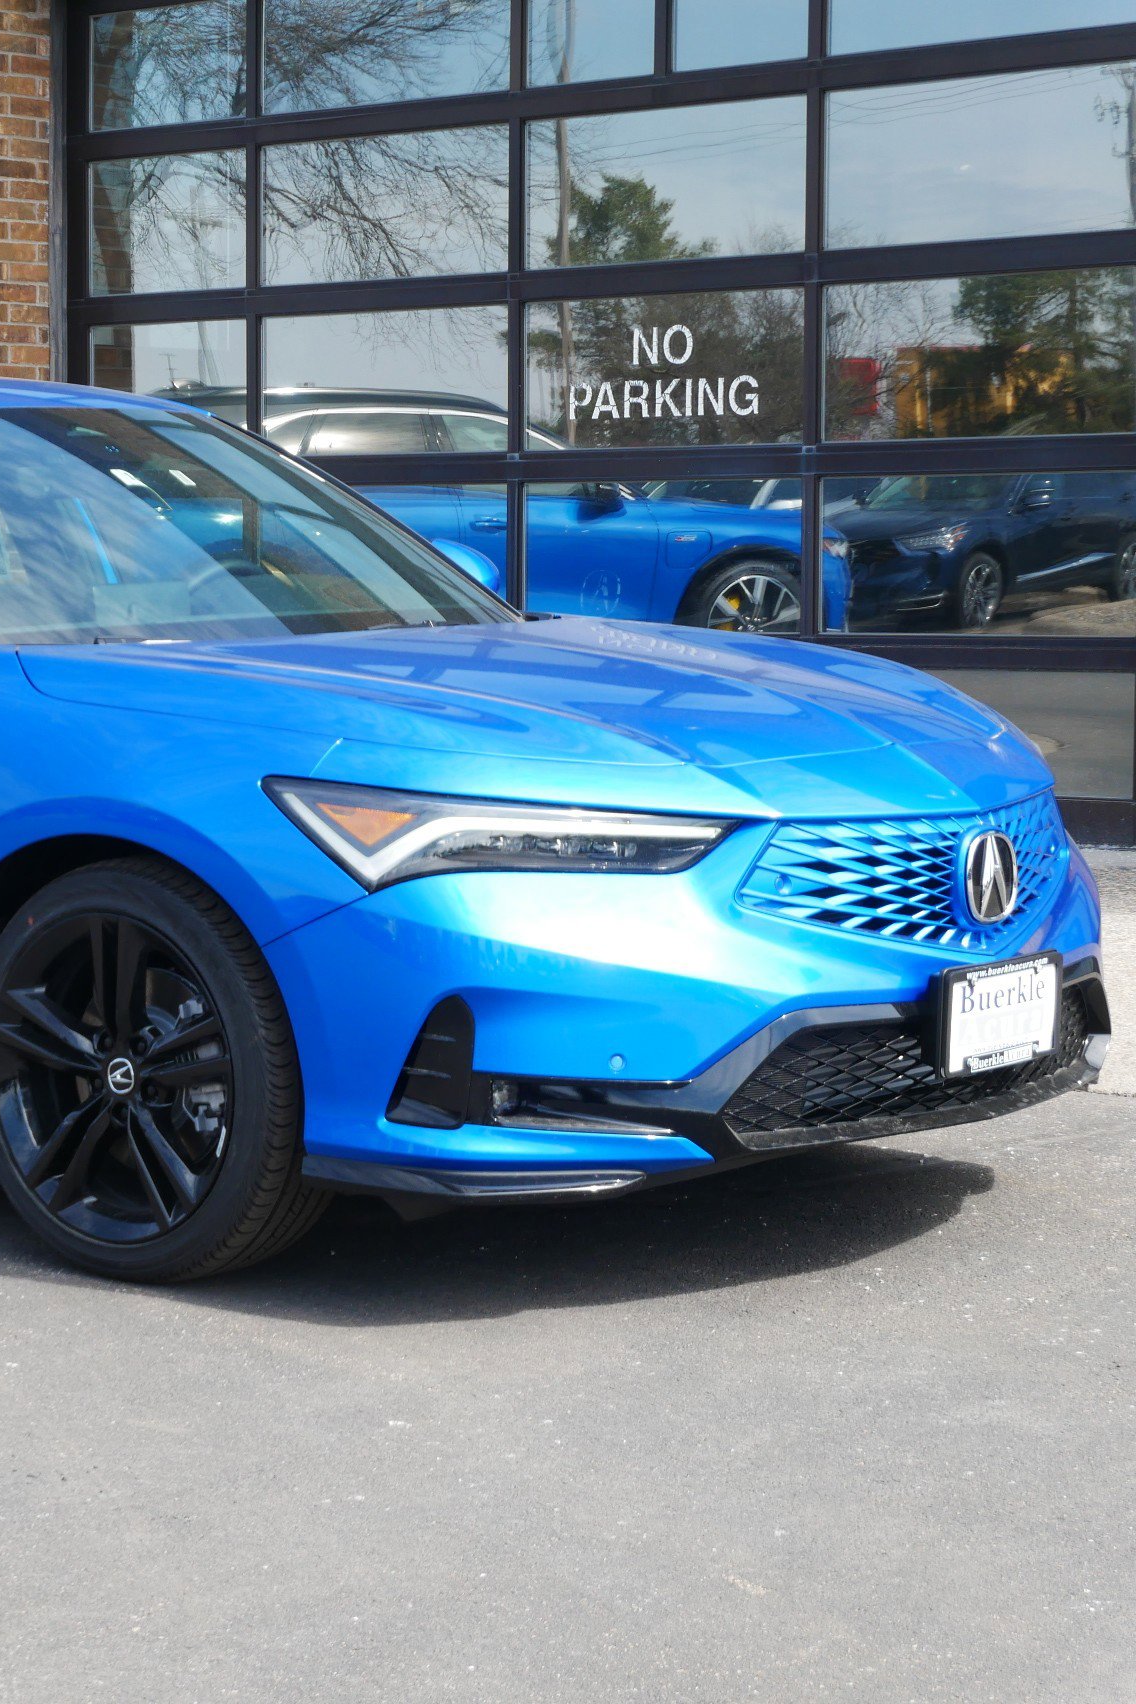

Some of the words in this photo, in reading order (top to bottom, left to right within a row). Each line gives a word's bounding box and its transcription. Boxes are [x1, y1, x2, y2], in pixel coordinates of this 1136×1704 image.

[632, 324, 694, 365] NO
[569, 375, 759, 420] PARKING
[966, 957, 1049, 980] www.buerkleacura.com
[960, 974, 1045, 1014] Buerkle
